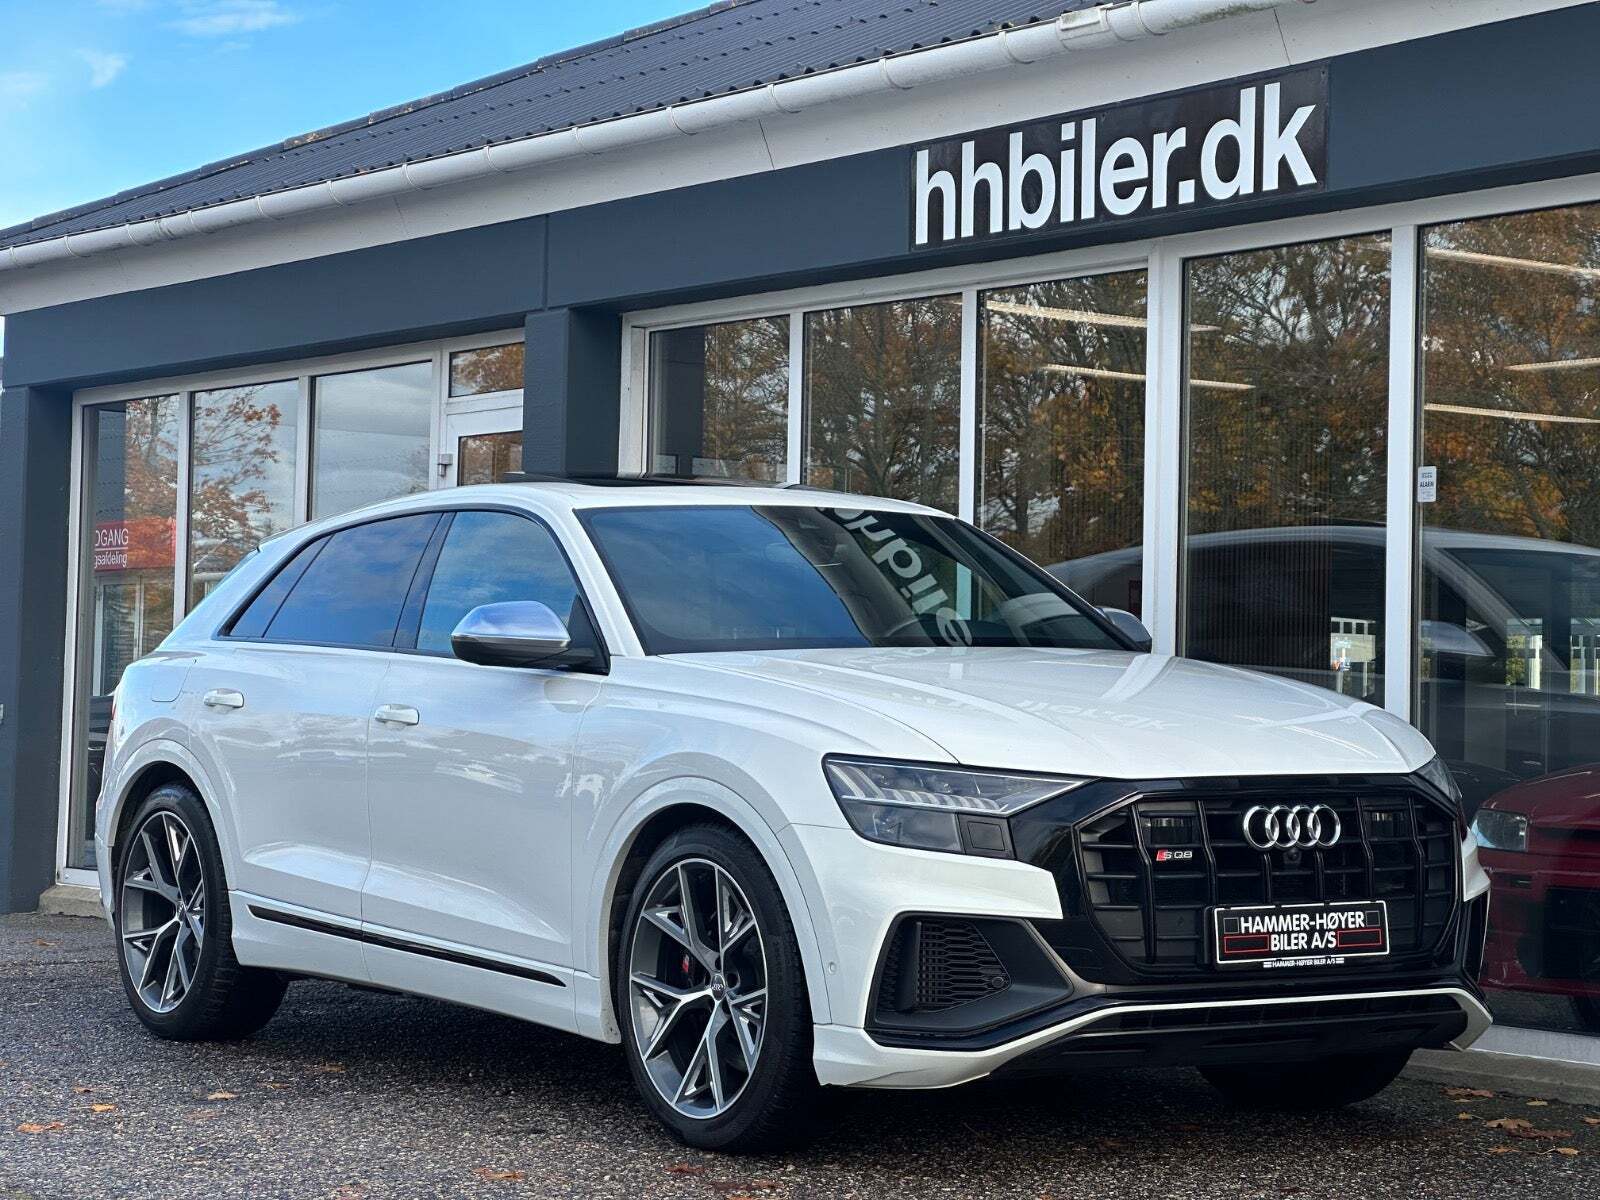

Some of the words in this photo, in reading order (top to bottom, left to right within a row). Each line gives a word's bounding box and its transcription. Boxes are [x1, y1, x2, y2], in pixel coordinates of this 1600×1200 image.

[915, 82, 1318, 246] hhbiler.dk
[1240, 911, 1365, 934] HAMMER-HØYER
[1271, 932, 1308, 951] BILER
[1311, 931, 1336, 949] A/S
